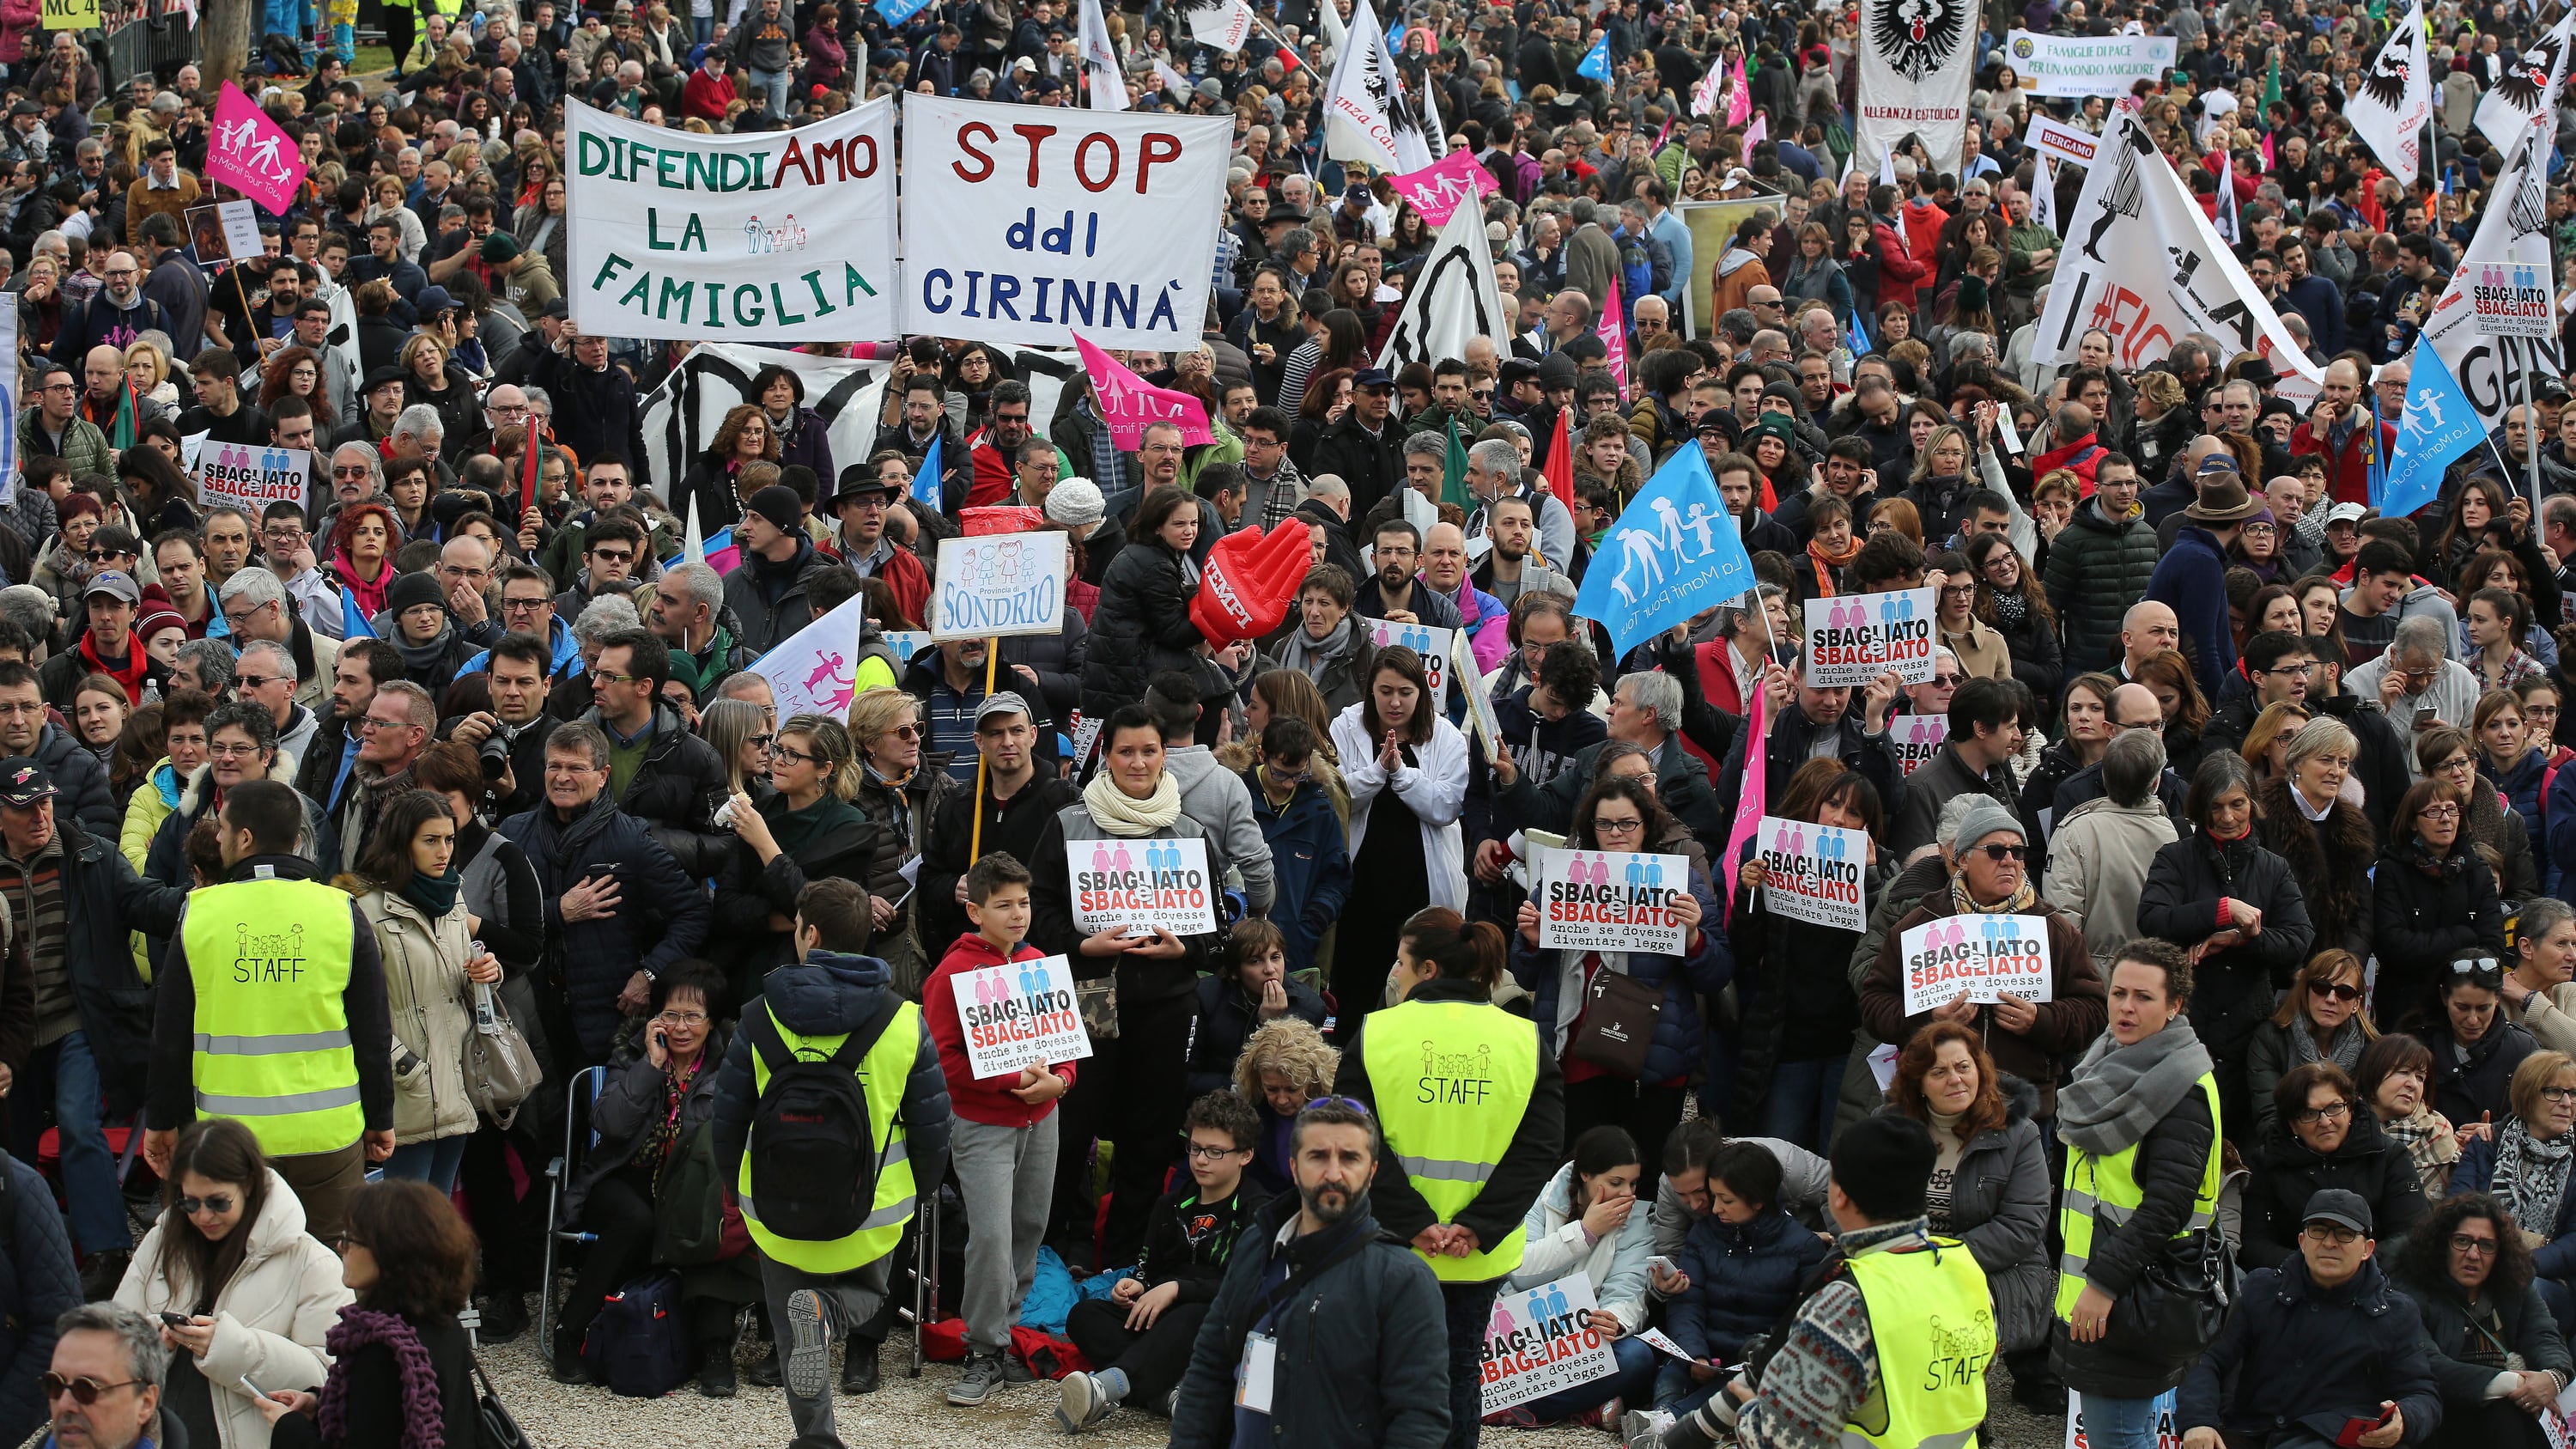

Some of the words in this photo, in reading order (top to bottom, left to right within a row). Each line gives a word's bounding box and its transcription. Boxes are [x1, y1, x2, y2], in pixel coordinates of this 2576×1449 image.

[2047, 45, 2094, 58] FAMIGLIE
[2096, 46, 2106, 57] DI
[2110, 45, 2132, 57] PACE
[2028, 60, 2044, 74] PER
[2046, 64, 2060, 76] UN
[2062, 64, 2104, 76] MONDO
[2107, 63, 2155, 76] MIGLIORE
[1864, 106, 1912, 119] ALLEANZA
[1916, 108, 1959, 120] CATTOLICA
[951, 121, 1183, 194] STOP
[2044, 131, 2093, 157] BERGAMO
[579, 131, 878, 192] DIFENDIAMO
[207, 150, 216, 163] La
[218, 156, 244, 177] Manif
[245, 170, 263, 187] Pour
[264, 181, 283, 202] Tous
[648, 207, 707, 252] LA
[592, 253, 878, 327] FAMIGLIA
[923, 268, 1183, 332] CIRINNÀ
[2474, 285, 2546, 303] SBAGLIATO
[2476, 298, 2548, 318] SBAGLIATO
[2477, 315, 2500, 324] anche
[2517, 317, 2549, 326] dovesse
[2480, 323, 2520, 332] diventare
[2524, 326, 2548, 336] legge
[204, 462, 302, 486] SBAGLIATO
[204, 477, 301, 500] SBAGLIATO
[204, 490, 234, 502] anche
[943, 574, 1055, 630] SONDRIO
[979, 586, 1012, 595] Provincia
[1204, 555, 1253, 630] TEMPI
[1814, 618, 1929, 648] SBAGLIATO
[1814, 637, 1929, 665] SBAGLIATO
[1815, 665, 1853, 674] anche
[1884, 660, 1929, 673] dovesse
[773, 671, 790, 695] La
[1078, 869, 1202, 892] SBAGLIATO
[1762, 849, 1858, 884] SBAGLIATO
[1080, 888, 1205, 912] SBAGLIATO
[1550, 881, 1680, 908] SBAGLIATO
[1764, 869, 1859, 904] SBAGLIATO
[1084, 911, 1122, 923] anche
[1131, 912, 1145, 921] se
[1153, 910, 1206, 921] dovesse
[1549, 900, 1680, 928] SBAGLIATO
[1769, 890, 1795, 904] anche
[1801, 898, 1812, 907] se
[1817, 900, 1860, 916] dovesse
[1774, 900, 1822, 920] diventare
[1828, 913, 1859, 928] legge
[1168, 922, 1204, 934] legge
[1550, 923, 1589, 935] anche
[1599, 927, 1614, 935] se
[1622, 926, 1678, 940] dovesse
[1553, 935, 1625, 947] diventare
[1635, 938, 1674, 952] legge
[1911, 939, 2041, 973] SBAGLIATO
[234, 958, 307, 983] STAFF
[1911, 953, 2043, 989] SBAGLIATO
[1913, 982, 1952, 1000] anche
[1961, 979, 1976, 988] se
[1984, 976, 2043, 987] dovesse
[965, 989, 1071, 1028] SBAGLIATO
[970, 1009, 1076, 1049] SBAGLIATO
[977, 1045, 1011, 1061] anche
[1017, 1043, 1029, 1053] se
[1035, 1033, 1081, 1050] dovesse
[983, 1053, 1041, 1073] diventare
[1047, 1045, 1082, 1061] legge
[1417, 1076, 1493, 1105] STAFF
[1480, 1308, 1593, 1362] BAGLIATO
[1479, 1327, 1601, 1385] BAGLIATO
[1526, 1372, 1541, 1384] se
[1549, 1350, 1606, 1375] dovesse
[1485, 1379, 1557, 1409] diventare
[1566, 1363, 1606, 1384] legge
